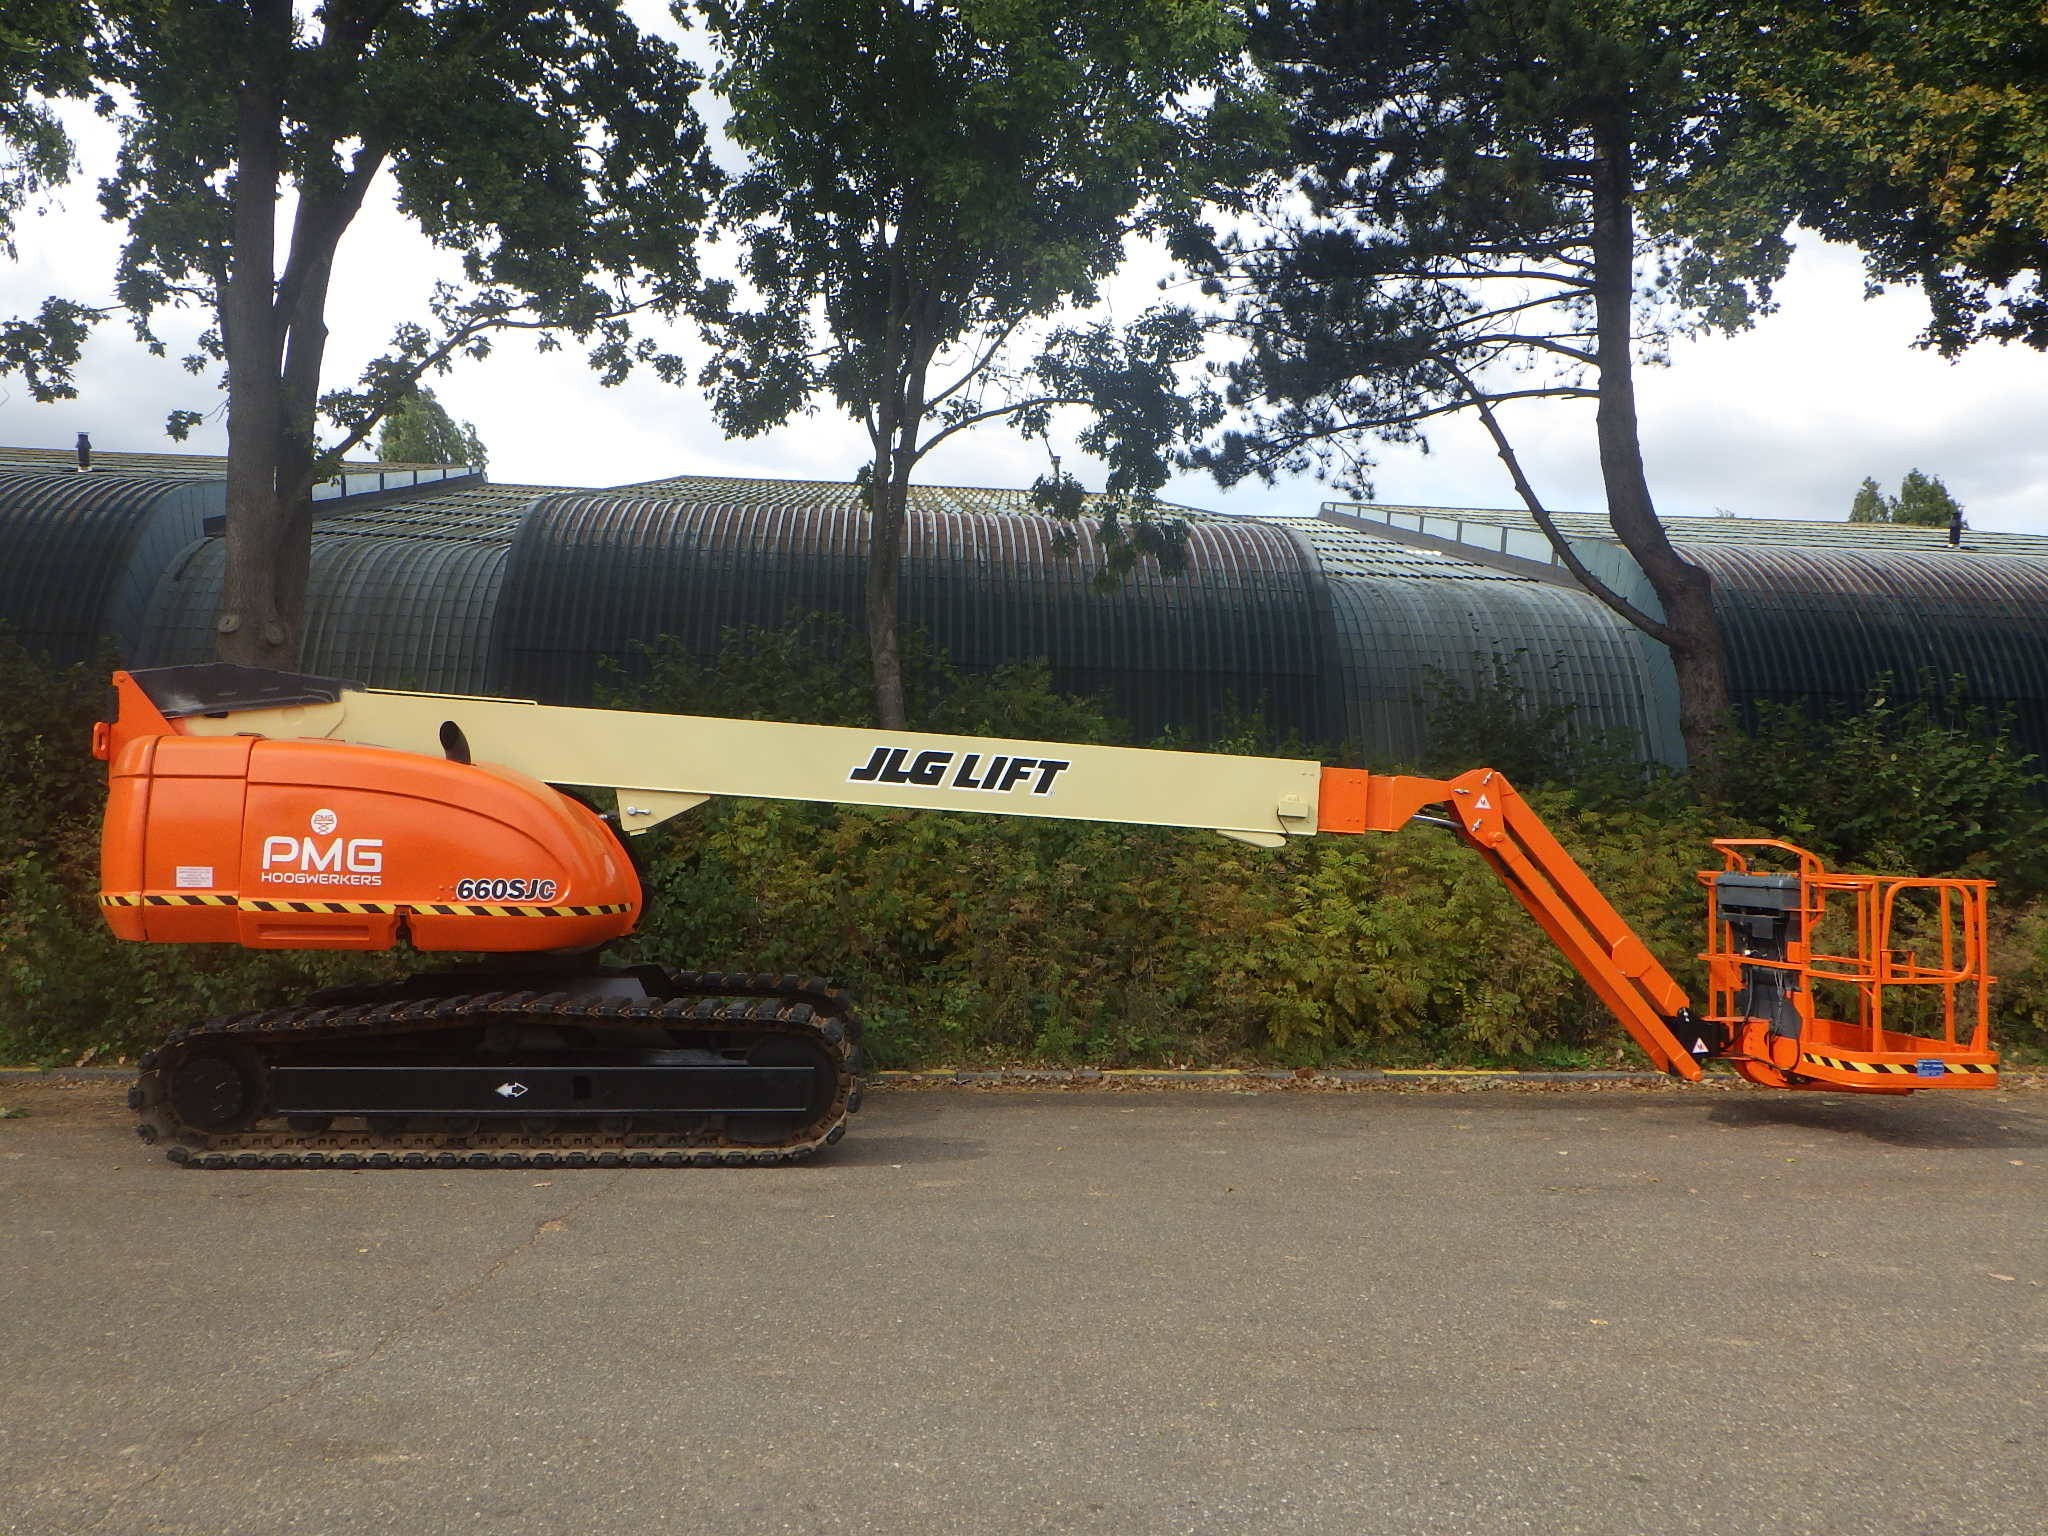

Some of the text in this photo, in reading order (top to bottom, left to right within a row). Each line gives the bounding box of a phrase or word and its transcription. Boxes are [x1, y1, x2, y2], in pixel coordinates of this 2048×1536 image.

[848, 746, 1071, 795] JLG LIFT
[262, 835, 383, 873] PMG
[260, 872, 382, 886] HOOGWERKERS
[457, 878, 556, 901] 660SJC
